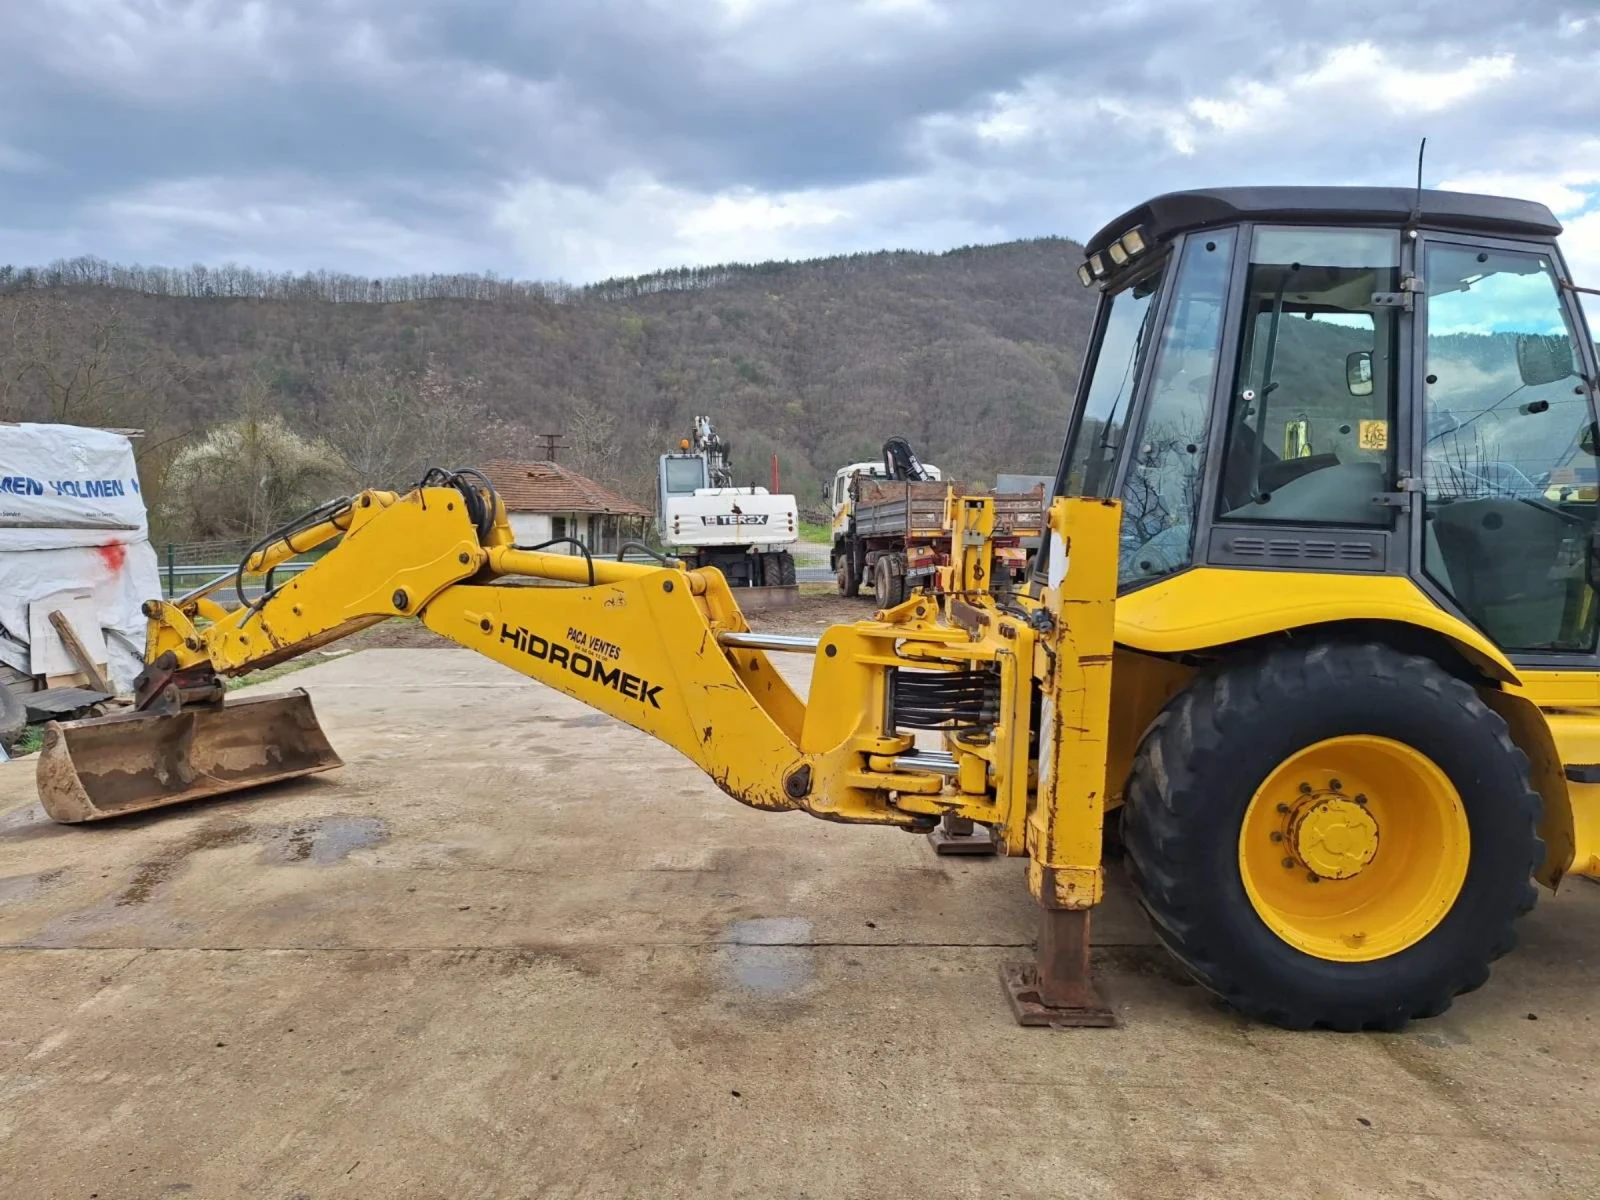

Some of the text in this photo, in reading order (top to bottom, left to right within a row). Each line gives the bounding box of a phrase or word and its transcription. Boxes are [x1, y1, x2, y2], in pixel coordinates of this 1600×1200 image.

[720, 515, 766, 525] TEREX
[566, 626, 587, 646] PACA
[589, 635, 621, 660] VENTES
